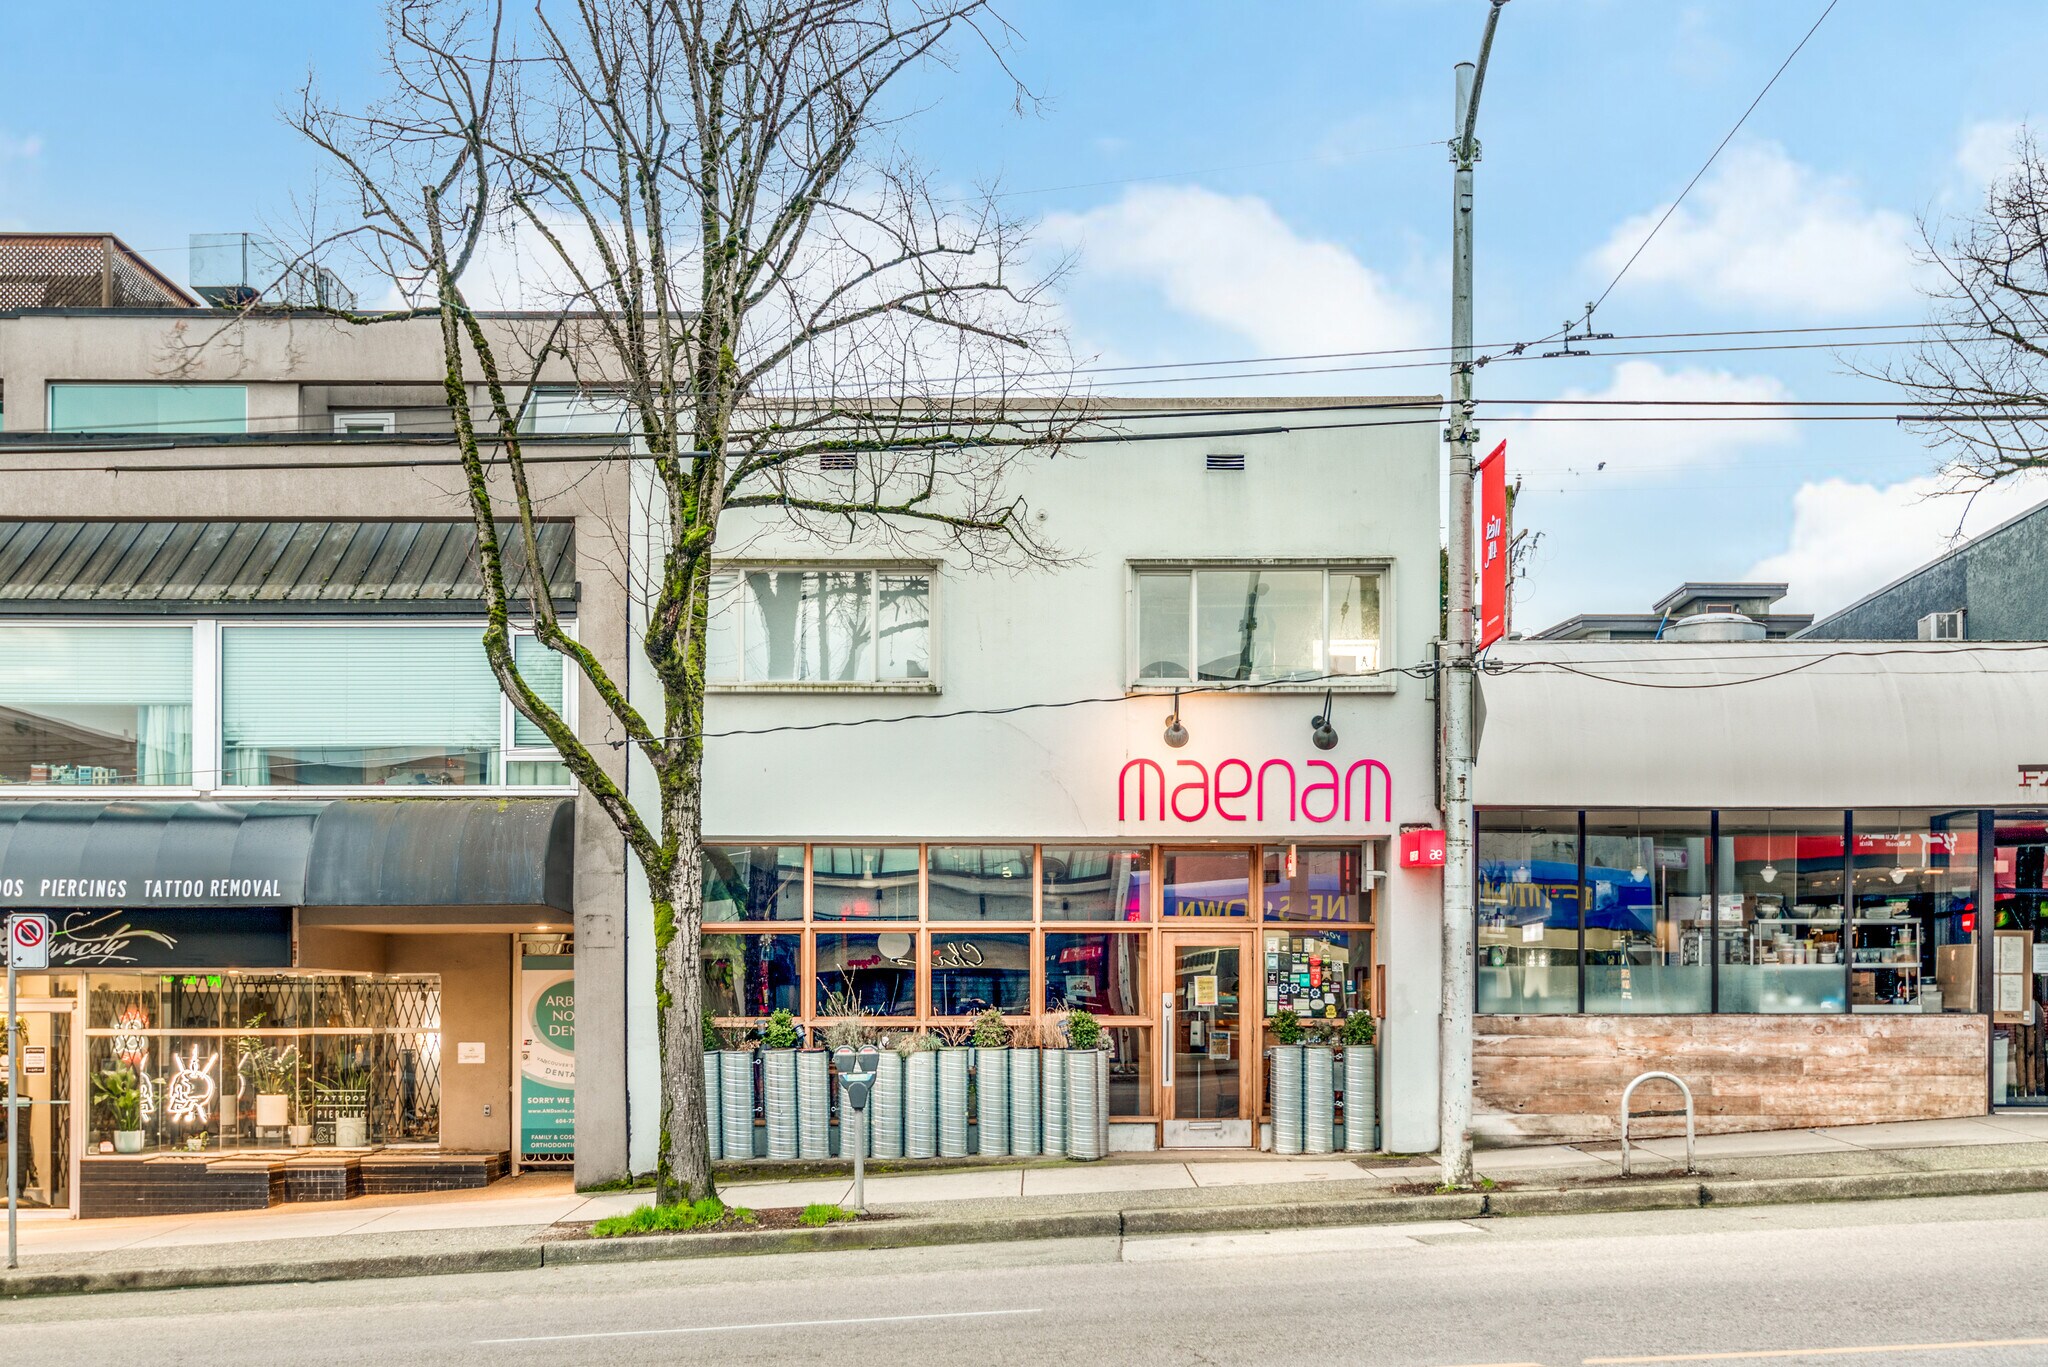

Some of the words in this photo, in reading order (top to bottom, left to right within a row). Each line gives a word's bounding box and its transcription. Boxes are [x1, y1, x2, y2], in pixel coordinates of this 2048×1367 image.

[1119, 758, 1391, 822] maenam
[0, 879, 24, 897] OS
[40, 879, 127, 897] PIERCINGS
[145, 879, 204, 897] TATTOO
[210, 879, 280, 897] REMOVAL
[545, 995, 574, 1008] ARB
[552, 1010, 575, 1022] NO
[545, 1068, 575, 1078] DENTA
[317, 1110, 365, 1119] PIERCING
